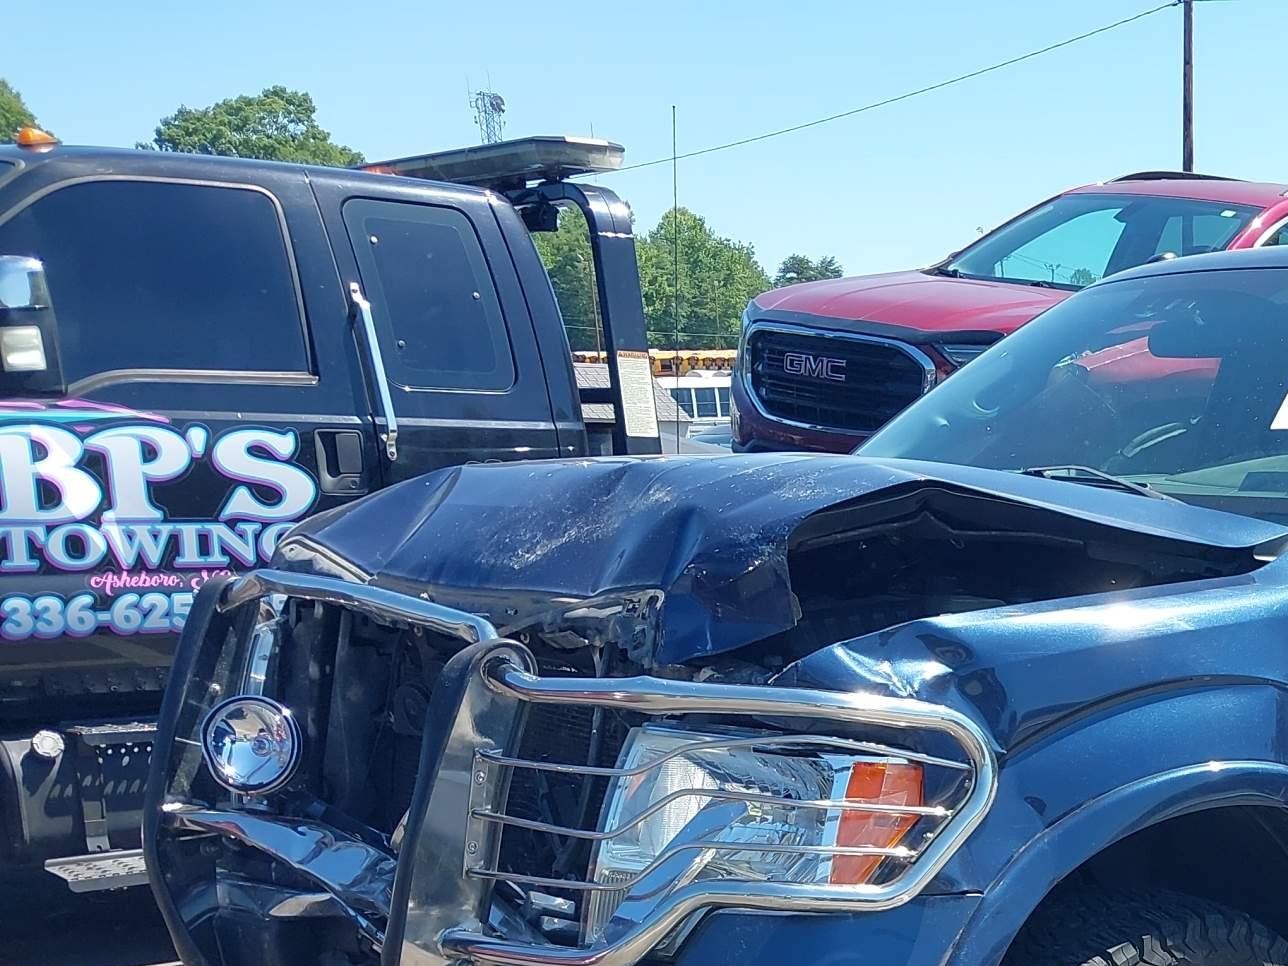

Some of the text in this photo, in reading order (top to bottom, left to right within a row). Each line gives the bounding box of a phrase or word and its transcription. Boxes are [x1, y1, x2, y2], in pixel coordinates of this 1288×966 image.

[784, 352, 846, 381] GMC
[0, 423, 318, 524] BP'S
[90, 570, 184, 596] Asheboro,
